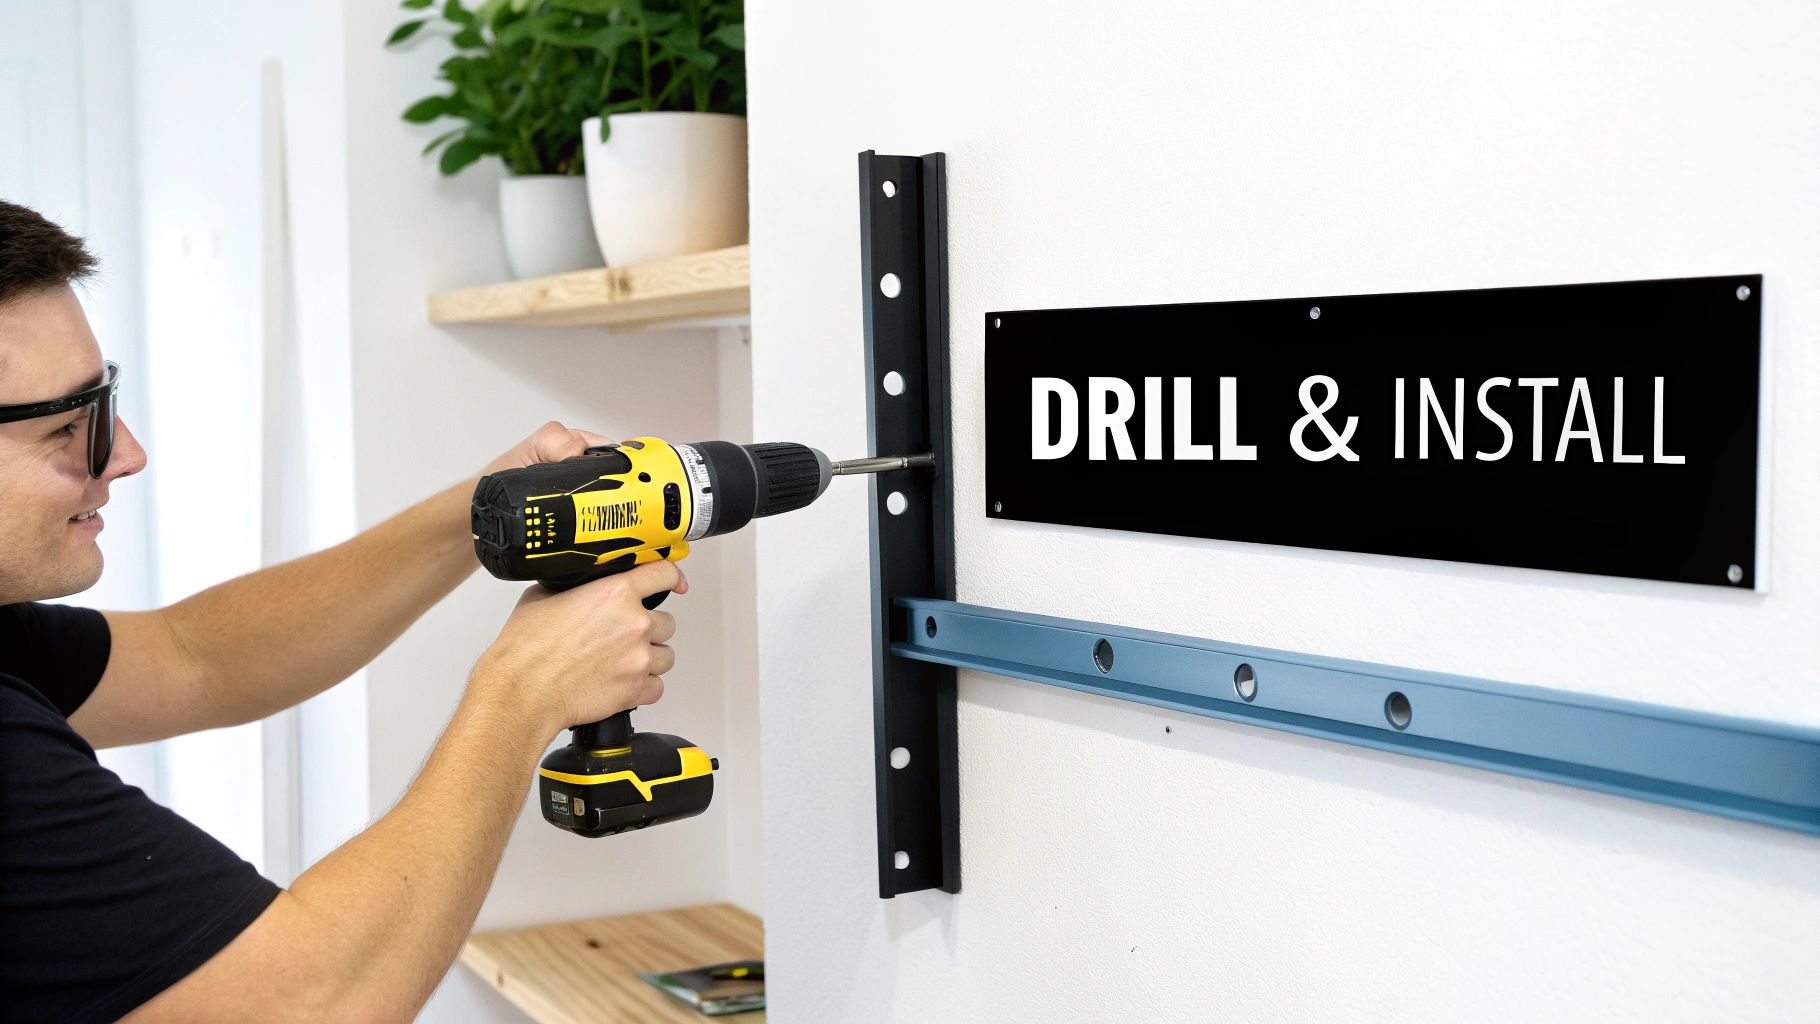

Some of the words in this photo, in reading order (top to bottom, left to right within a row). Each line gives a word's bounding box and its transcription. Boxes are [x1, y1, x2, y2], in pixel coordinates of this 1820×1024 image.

[1032, 377, 1257, 461] DRILL
[1290, 375, 1359, 462] &
[1395, 377, 1685, 464] INSTALL
